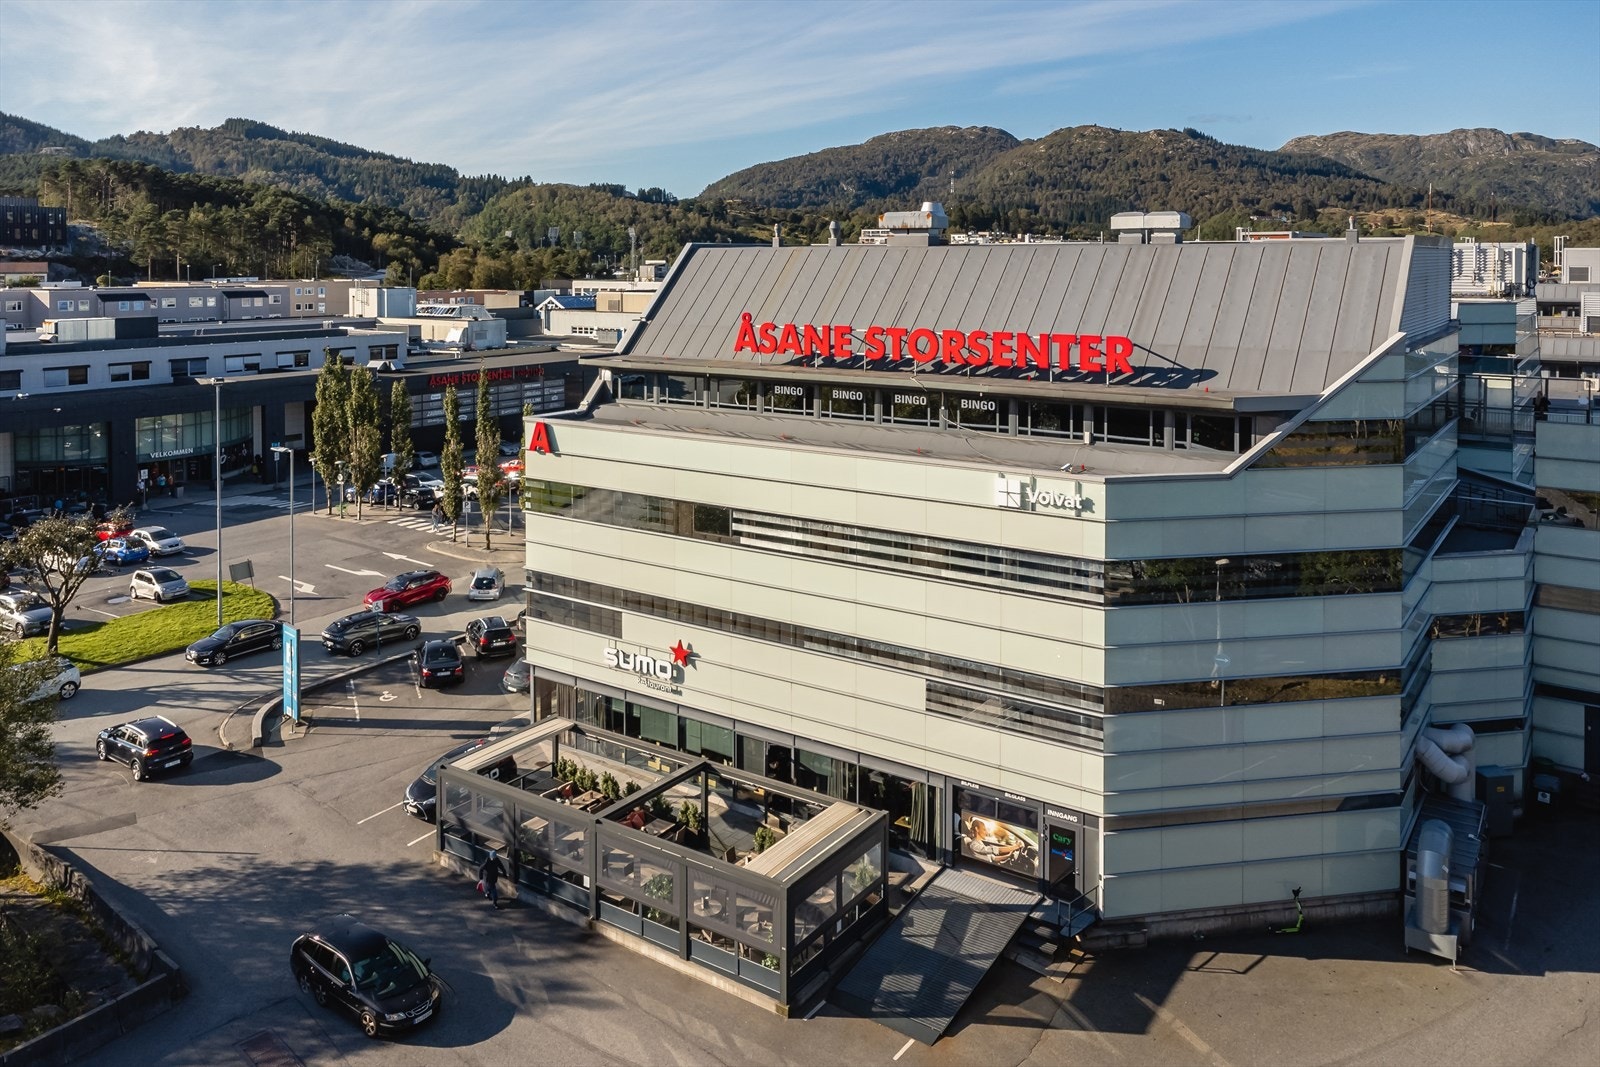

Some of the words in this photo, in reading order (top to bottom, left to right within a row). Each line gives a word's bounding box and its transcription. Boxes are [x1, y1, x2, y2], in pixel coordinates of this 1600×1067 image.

[734, 312, 853, 358] ÅSANE
[864, 326, 1135, 374] STORSENTER
[774, 384, 804, 397] BINGO
[832, 389, 864, 402] BINGO
[894, 394, 927, 407] BINGO
[960, 399, 996, 412] BINGO
[529, 422, 552, 453] A
[150, 448, 194, 458] VELKOMMEN
[1026, 486, 1082, 509] Volvat
[1047, 809, 1078, 823] INNGANG
